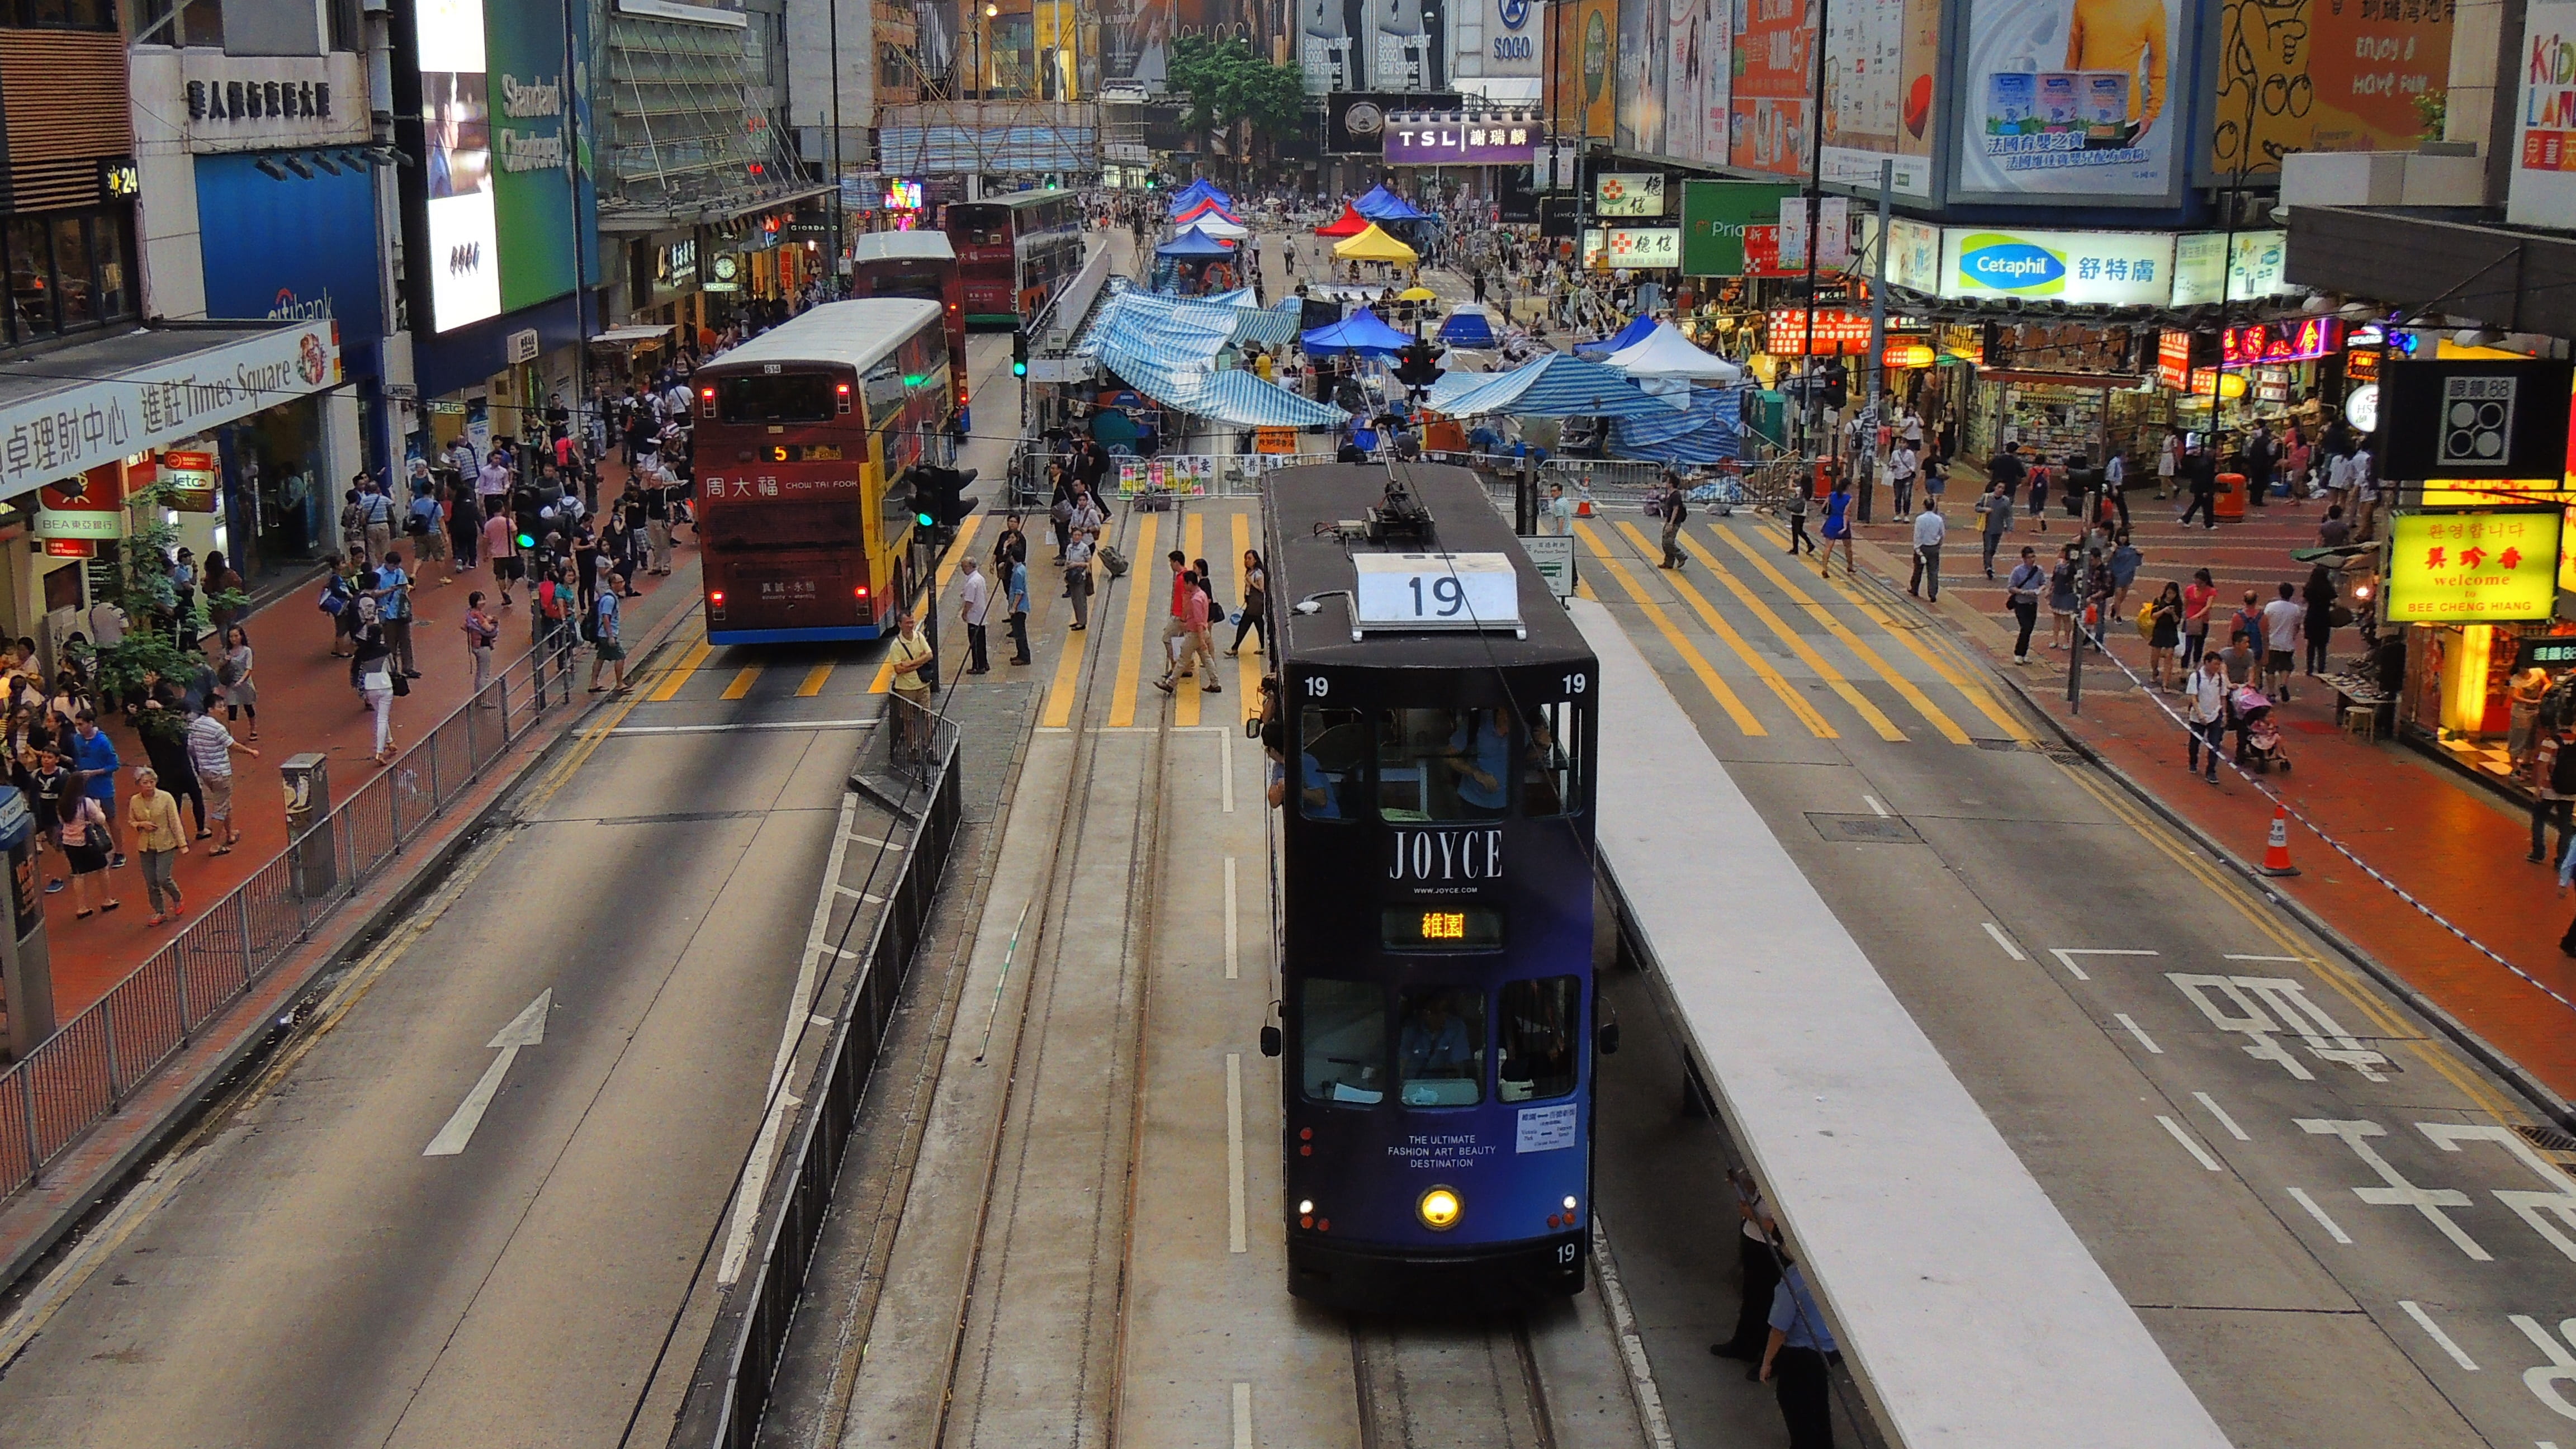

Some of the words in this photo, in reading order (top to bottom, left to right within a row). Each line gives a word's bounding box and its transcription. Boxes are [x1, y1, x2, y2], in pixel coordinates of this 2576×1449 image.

[1305, 38, 1322, 50] SAINT
[1323, 36, 1353, 50] LAURENT
[1379, 35, 1397, 49] SAINT
[1399, 34, 1431, 48] LAURENT
[1494, 36, 1532, 59] SOGO
[1305, 50, 1323, 63] SOGO
[1379, 49, 1398, 62] SOGO
[1305, 63, 1319, 75] NEW
[1320, 62, 1341, 75] STORE
[1379, 63, 1394, 74] NEW
[1395, 61, 1418, 74] STORE
[503, 74, 560, 118] Standard
[1399, 131, 1456, 146] TSL
[1470, 129, 1527, 146] 謝瑞麟
[500, 127, 563, 173] Chartered
[122, 167, 138, 193] 24
[1977, 255, 2047, 278] Cetaphil
[2078, 257, 2156, 282] 舒特膚
[435, 404, 464, 413] Jetco
[2357, 405, 2376, 414] HS
[0, 396, 129, 484] 卓理財中心
[182, 373, 233, 417] Times
[236, 360, 291, 409] Square
[774, 446, 787, 461] 5
[706, 476, 778, 498] 周大福
[43, 520, 70, 529] BEA
[72, 520, 112, 529] 東亞銀行
[2428, 522, 2525, 539] 환영합니다
[2433, 574, 2510, 586] welcome
[1408, 576, 1463, 617] 19
[2408, 602, 2433, 613] BEE
[2440, 602, 2485, 612] CHENG
[2491, 602, 2531, 611] HIANG
[1305, 676, 1328, 697] 19
[1562, 673, 1586, 694] 19
[1389, 830, 1502, 880] JOYCE
[1422, 912, 1464, 938] 維園
[1409, 1135, 1427, 1144] THE
[1431, 1135, 1476, 1144] ULTIMATE
[1388, 1147, 1429, 1156] FASHION
[1434, 1147, 1453, 1156] ART
[1459, 1146, 1496, 1156] BEAUTY
[1410, 1158, 1474, 1168] DESTINATION
[1557, 1243, 1575, 1264] 19
